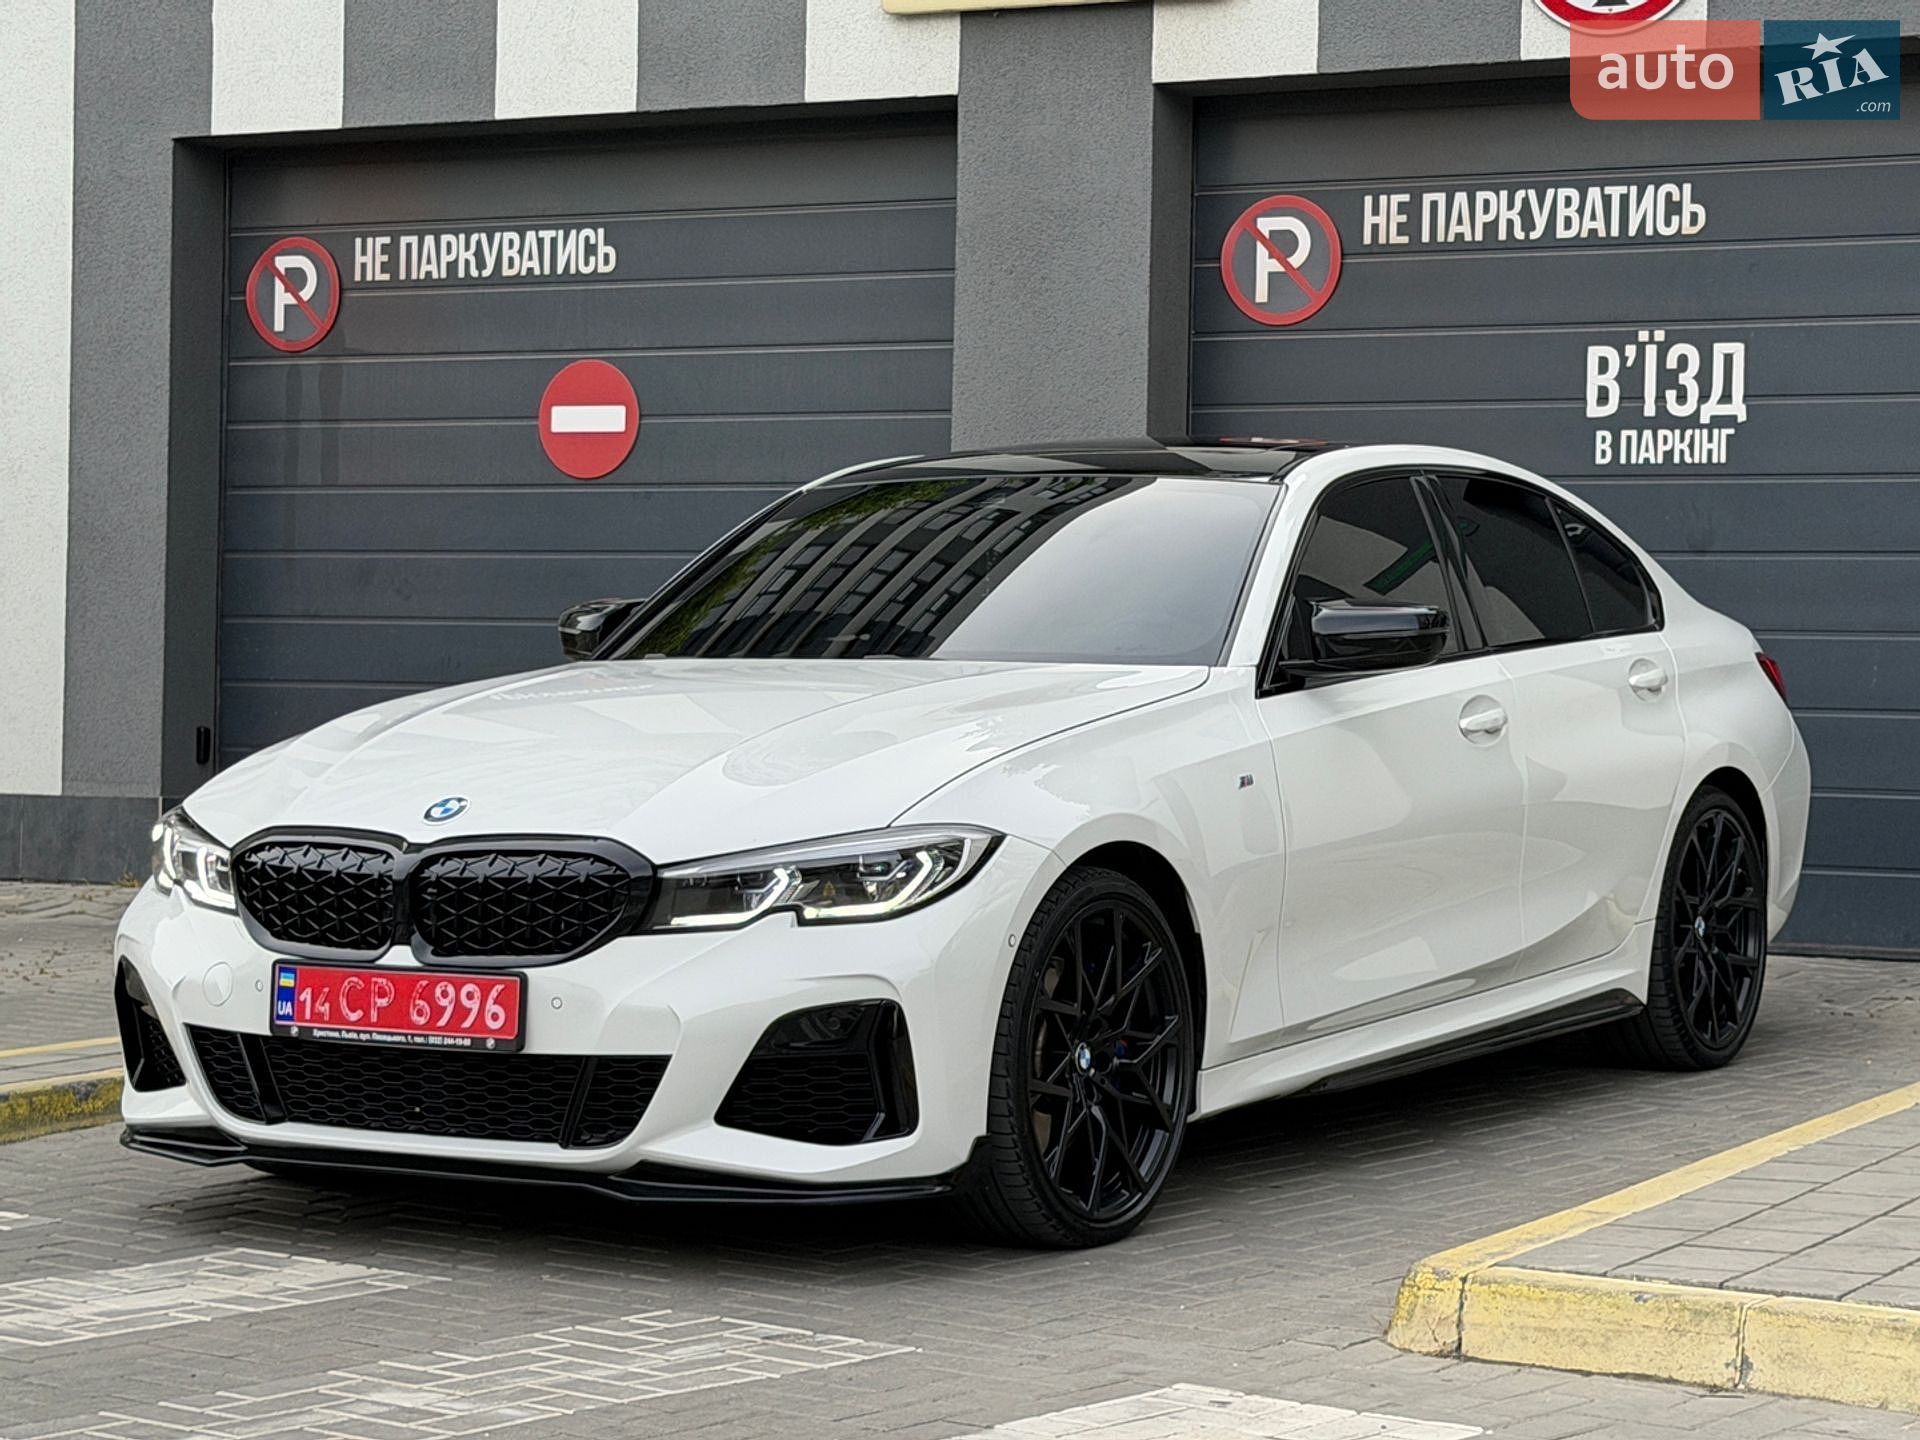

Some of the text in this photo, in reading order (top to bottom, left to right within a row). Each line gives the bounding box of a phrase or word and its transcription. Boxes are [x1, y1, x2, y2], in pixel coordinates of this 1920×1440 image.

[1362, 182, 1707, 246] НЕ ПАРКУВАТИСЬ
[354, 227, 617, 282] НЕ ПАРКУВАТИСЬ
[1595, 427, 1736, 466] В ПАРКІНГ
[278, 1000, 293, 1016] UA
[299, 986, 331, 1021] 14
[410, 979, 507, 1031] 6996
